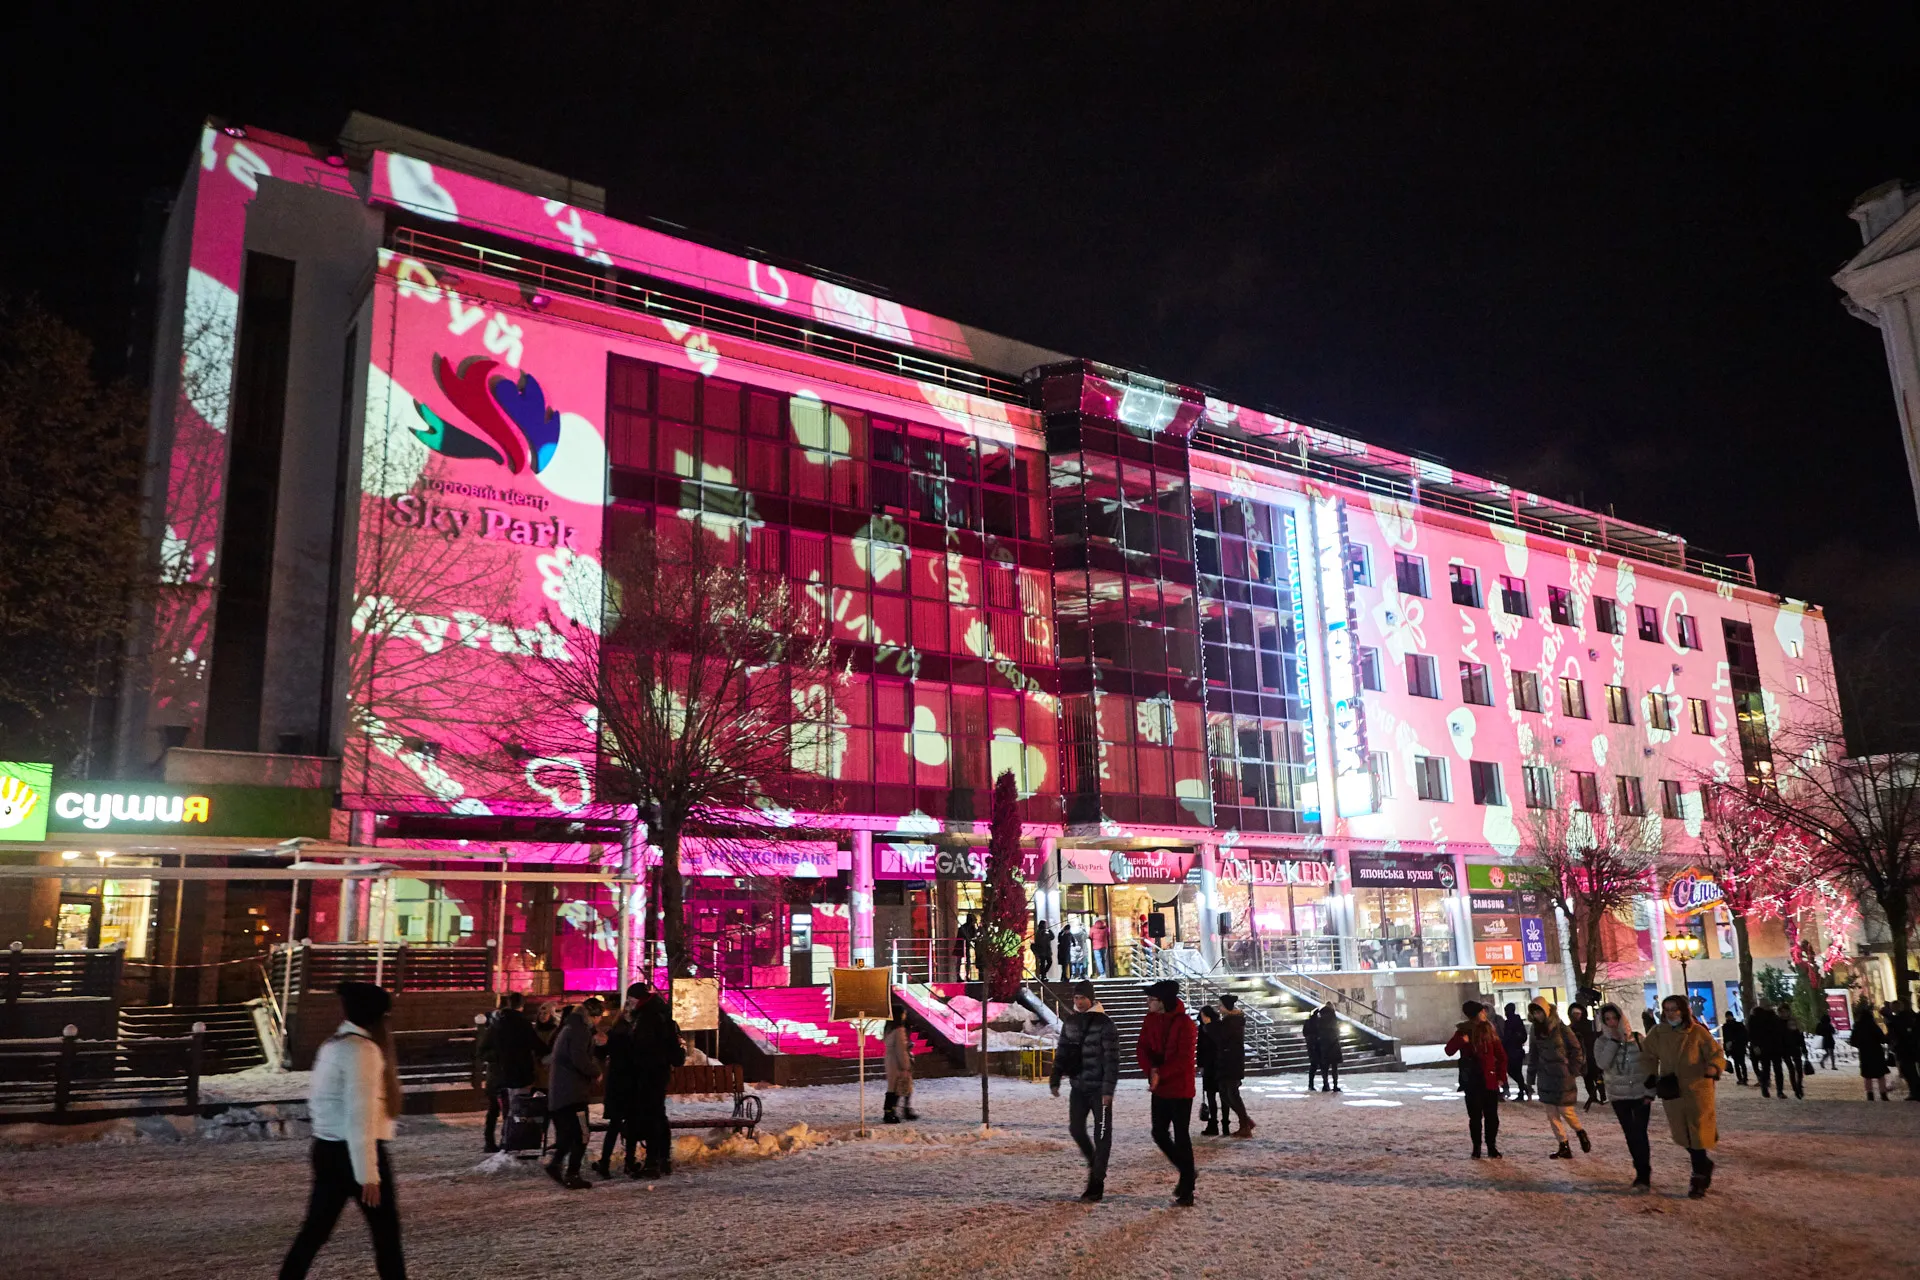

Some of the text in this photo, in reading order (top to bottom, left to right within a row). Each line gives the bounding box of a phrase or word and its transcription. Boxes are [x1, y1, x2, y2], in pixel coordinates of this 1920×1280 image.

[390, 493, 580, 551] Sky Park
[55, 791, 210, 829] сушия
[1123, 866, 1171, 879] ШОПІНГУ
[1261, 860, 1334, 884] BAKERY
[1360, 869, 1434, 882] японська кухня
[1473, 899, 1505, 909] SAMSUNG
